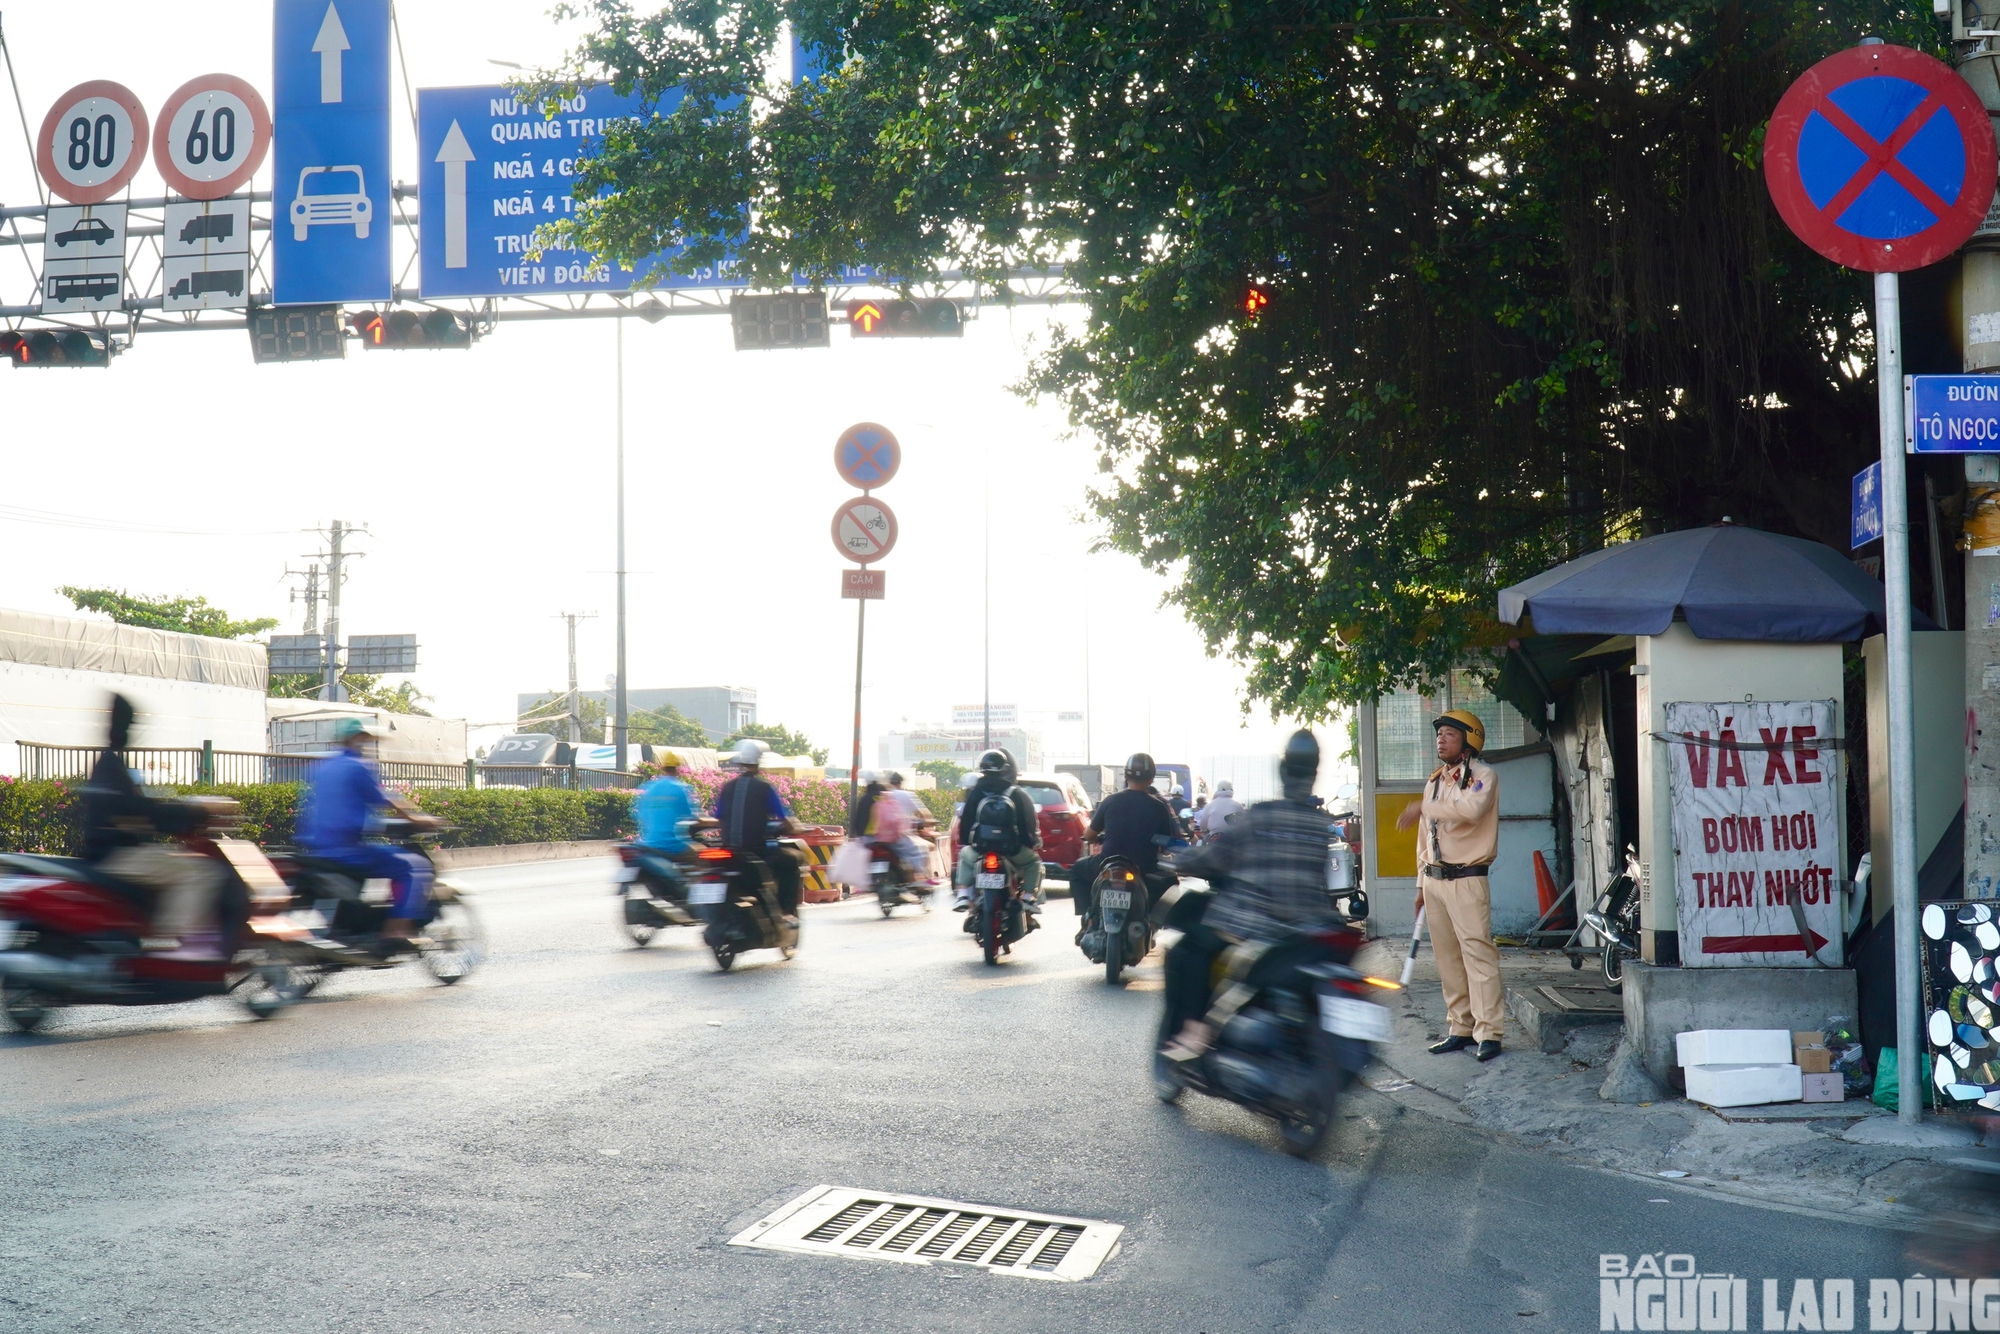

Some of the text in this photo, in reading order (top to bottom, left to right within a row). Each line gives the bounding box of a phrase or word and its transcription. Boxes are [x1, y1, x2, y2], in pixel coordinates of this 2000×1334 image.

[68, 114, 116, 171] 80
[185, 107, 235, 165] 60
[491, 116, 641, 144] QUANG TRU
[493, 152, 535, 179] NGÃ
[542, 159, 555, 177] 4
[493, 190, 534, 216] NGÃ
[542, 197, 555, 214] 4
[553, 259, 610, 284] ĐÔNG
[1947, 380, 1998, 402] ĐƯỜN
[1919, 413, 1998, 446] TÔ NGỌC
[850, 571, 873, 584] CẤM
[914, 743, 950, 752] HOTEL
[1684, 717, 1822, 788] VÁ XE
[1702, 811, 1817, 854] BƠM HƠI
[1692, 860, 1833, 909] THAY NHỚT
